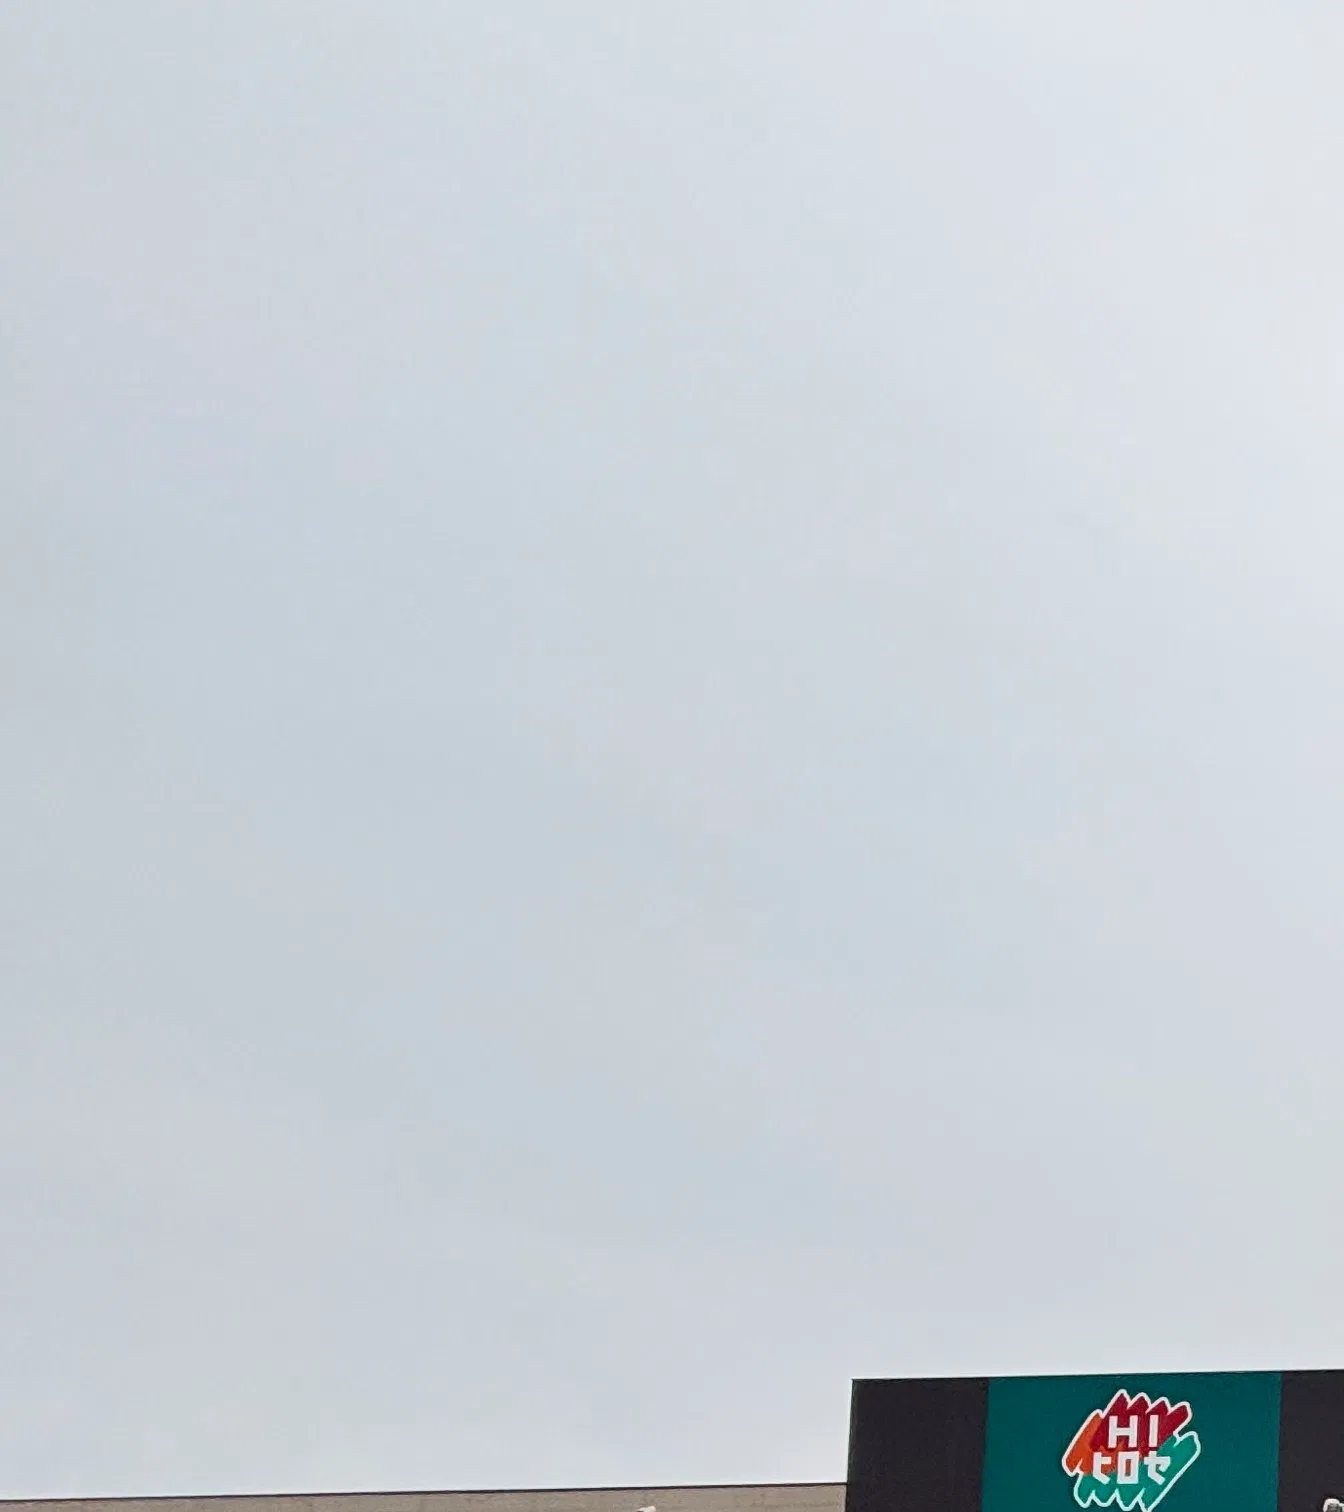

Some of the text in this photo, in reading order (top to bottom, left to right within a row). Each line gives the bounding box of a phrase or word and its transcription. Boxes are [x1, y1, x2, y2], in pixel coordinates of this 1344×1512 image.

[1108, 1414, 1159, 1448] HI
[1092, 1450, 1171, 1485] ヒロセ
